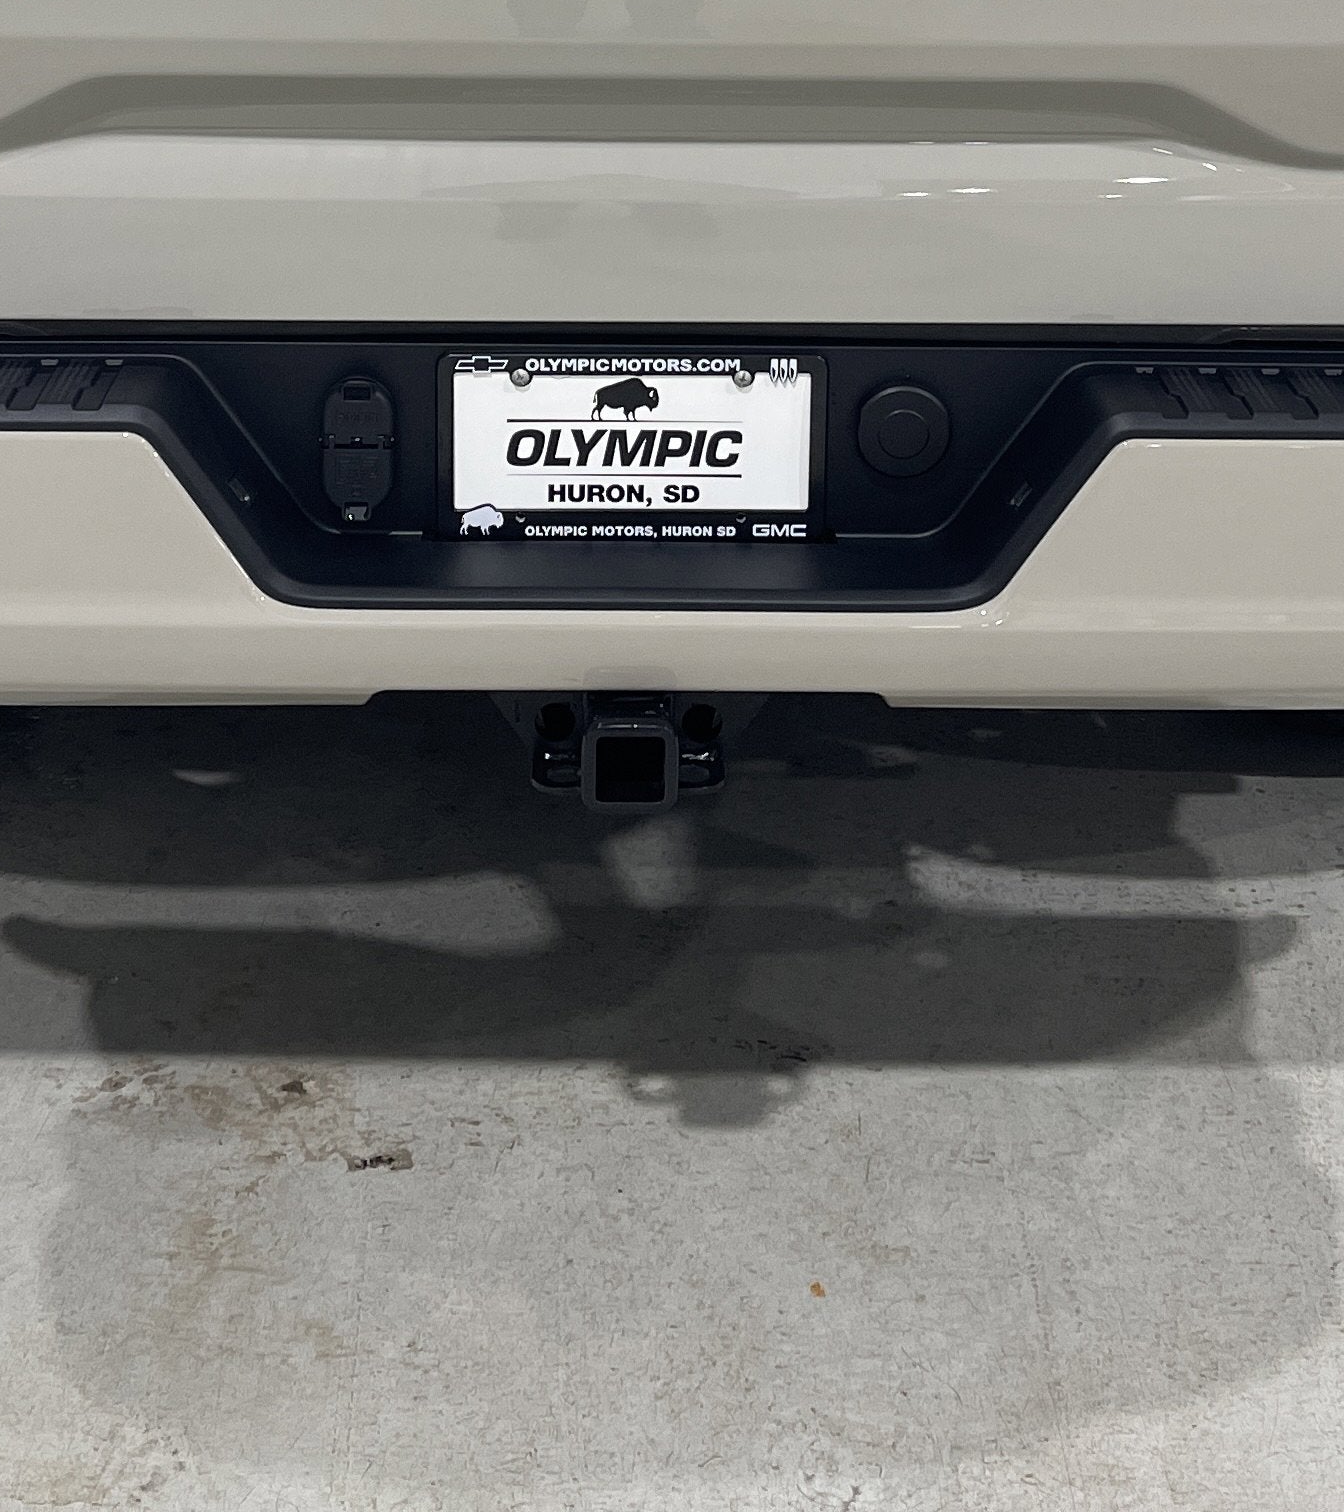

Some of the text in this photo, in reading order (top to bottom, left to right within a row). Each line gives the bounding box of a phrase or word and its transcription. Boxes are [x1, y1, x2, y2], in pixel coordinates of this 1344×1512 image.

[525, 358, 741, 373] OLYMPICMOTORS.COM
[506, 429, 743, 468] OLYMPIC
[548, 484, 700, 507] HURON, SD
[524, 524, 807, 538] OLYMPIC MOTORS, HURON SD GMC
